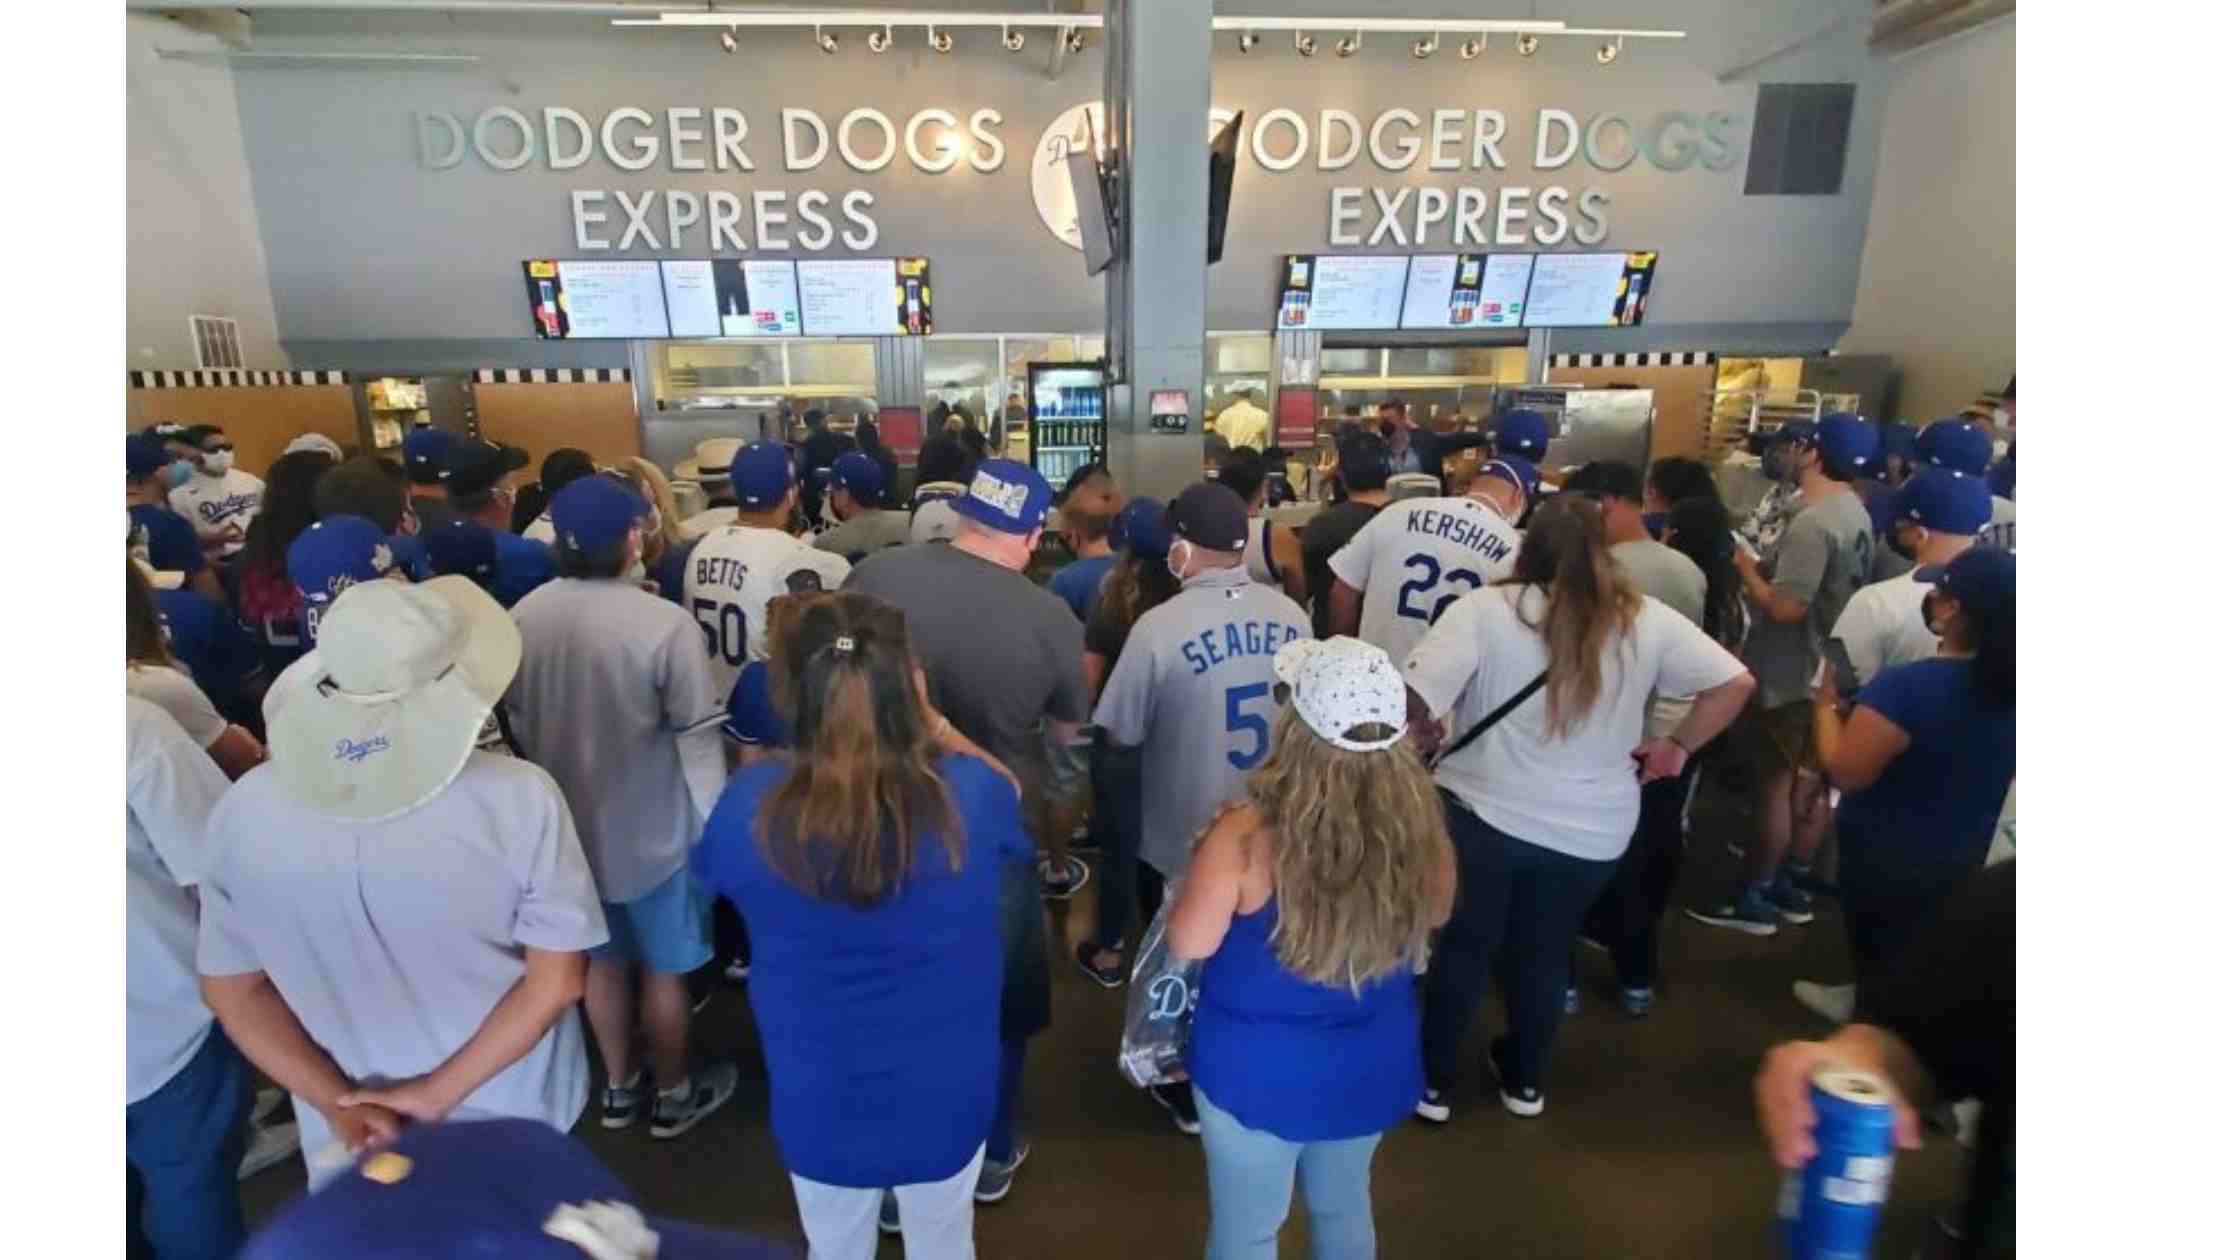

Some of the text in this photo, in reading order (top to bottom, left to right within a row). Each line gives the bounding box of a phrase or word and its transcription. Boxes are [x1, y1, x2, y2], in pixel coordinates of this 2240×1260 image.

[414, 105, 1005, 174] DODGER DOGS
[1209, 107, 1742, 172] ODGER DOGS
[571, 189, 880, 251] EXPRESS
[1329, 185, 1609, 246] EXPRESS
[1406, 509, 1512, 564] KERSHAW
[696, 557, 749, 592] BETTS
[691, 596, 747, 668] 50
[1224, 681, 1270, 771] 5
